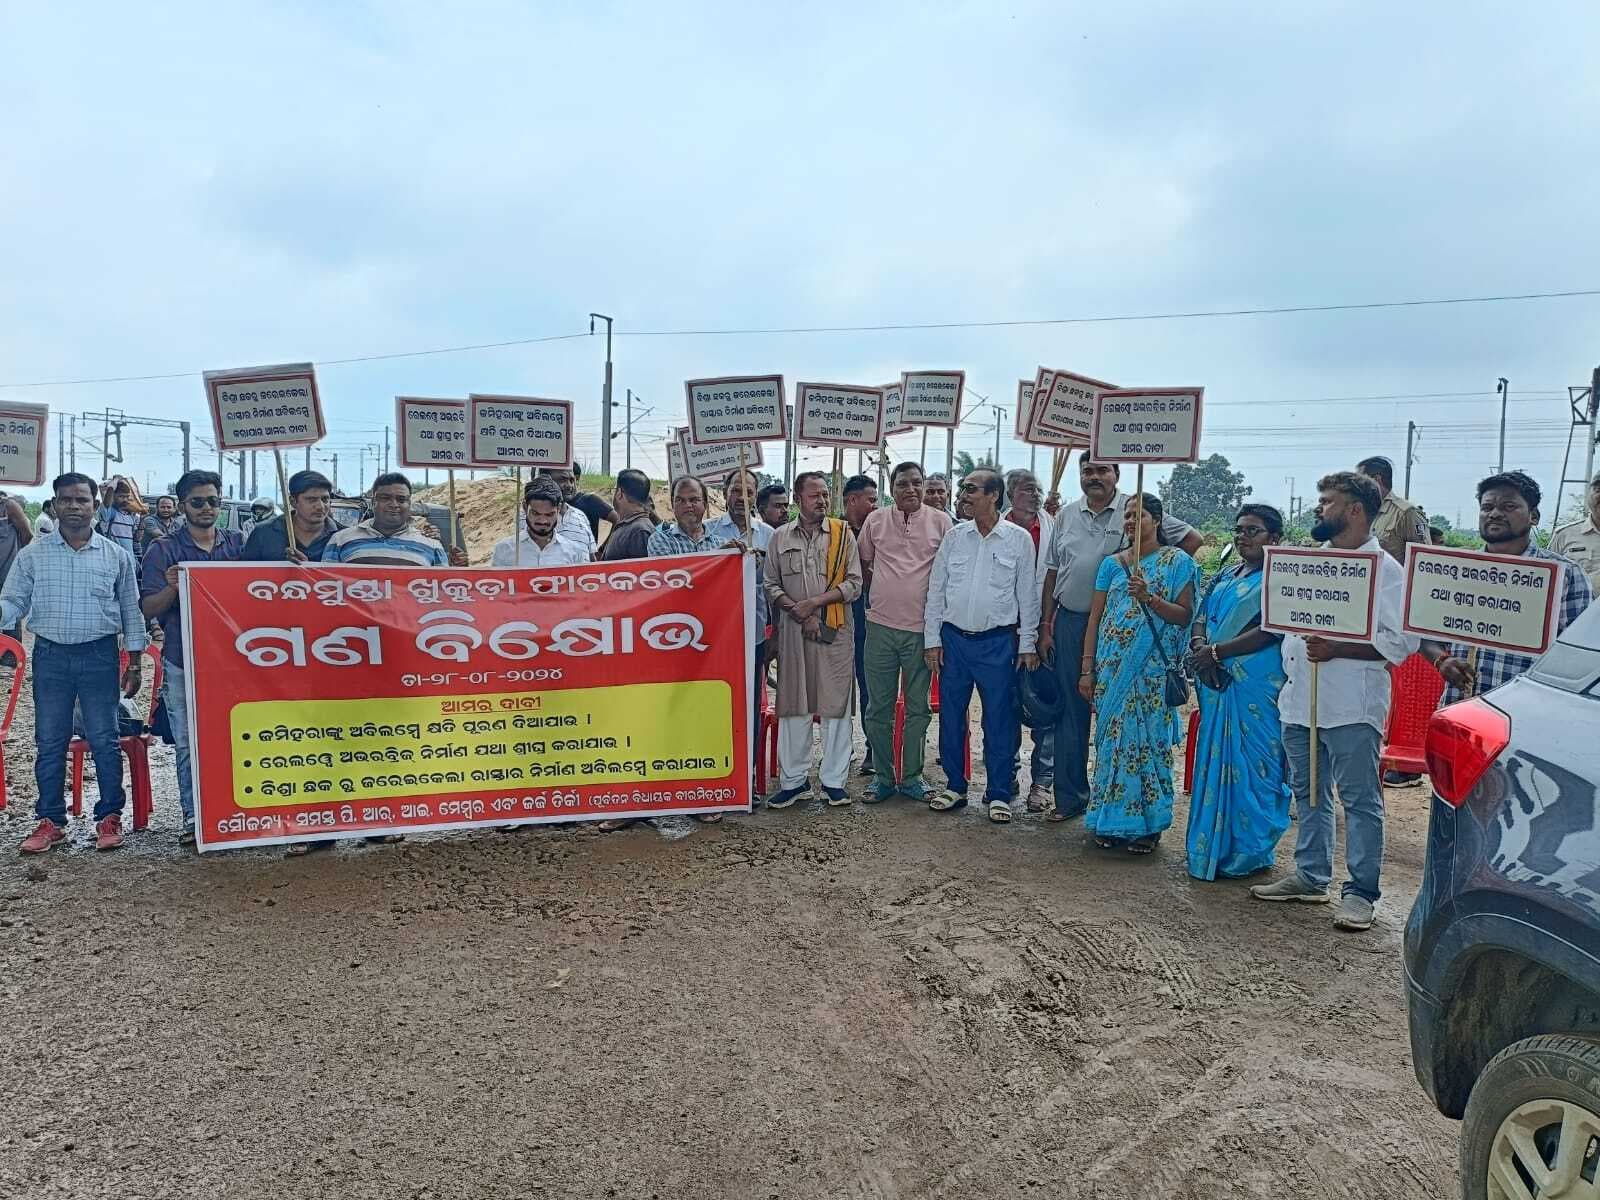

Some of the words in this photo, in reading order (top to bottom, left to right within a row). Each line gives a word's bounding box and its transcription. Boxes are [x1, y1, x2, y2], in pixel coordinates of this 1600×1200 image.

[496, 446, 524, 457] ଆମର
[527, 447, 550, 458] ଦାବୀ
[247, 578, 393, 606] ବନ୍ଧମୁଣ୍ଡା
[529, 568, 693, 595] ଫାଟକରେ
[1511, 569, 1543, 589] ନିର୍ମାଣ
[1430, 588, 1450, 601] ଯଥା
[1477, 595, 1521, 613] କରାଯାଉ
[1290, 611, 1313, 625] ଆମର
[1315, 613, 1335, 626] ଦାବୀ
[1443, 616, 1473, 633] ଆମର
[1476, 621, 1502, 637] ଦାବୀ
[235, 625, 383, 667] ଗଣ
[415, 608, 711, 663] ବିକ୍ଷୋଭ
[441, 699, 493, 713] ଆମର
[500, 696, 543, 709] ଦାବୀ
[349, 722, 421, 739] ଅବିଲମ୍ବେ
[427, 718, 456, 734] କ୍ଷତି
[463, 719, 507, 734] ପୂରଣ
[512, 714, 577, 729] ଦିଆଯାଉ
[420, 742, 468, 759] ନିର୍ମାଣ
[474, 743, 507, 756] ଯଥା
[551, 737, 617, 751] କରାଯାଉ
[303, 779, 333, 793] ଛକ
[529, 762, 575, 778] ନିର୍ମାଣ
[580, 758, 647, 777] ଅବିଲମ୍ବେ
[651, 757, 716, 772] କରାଯାଉ
[295, 809, 336, 827] ସମସ୍ତ
[438, 799, 485, 820] ମେମ୍ବର
[491, 796, 518, 812] ଏବଂ
[522, 791, 547, 810] ଜର୍ଜ
